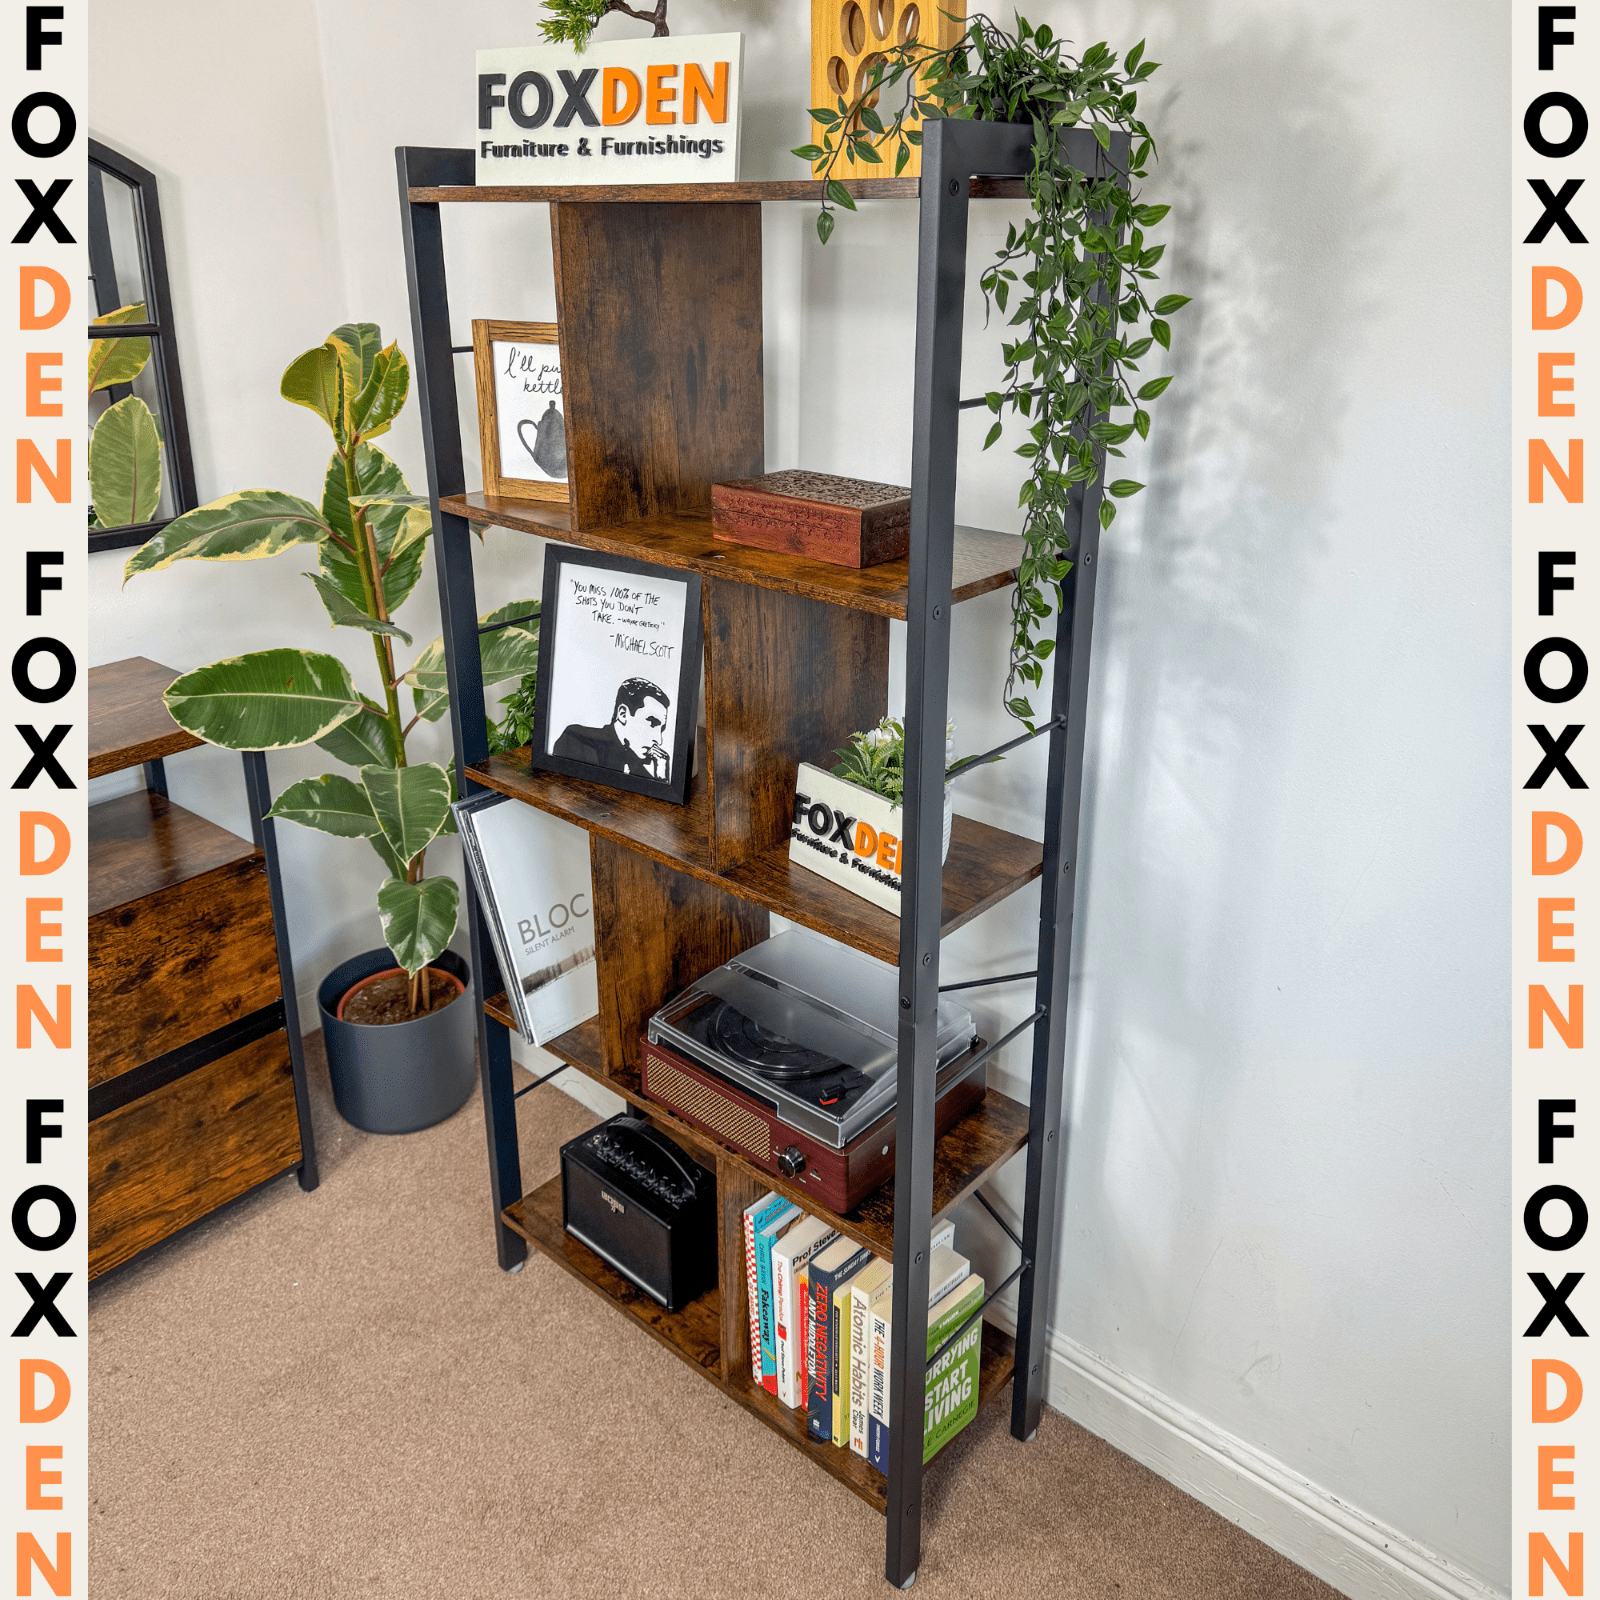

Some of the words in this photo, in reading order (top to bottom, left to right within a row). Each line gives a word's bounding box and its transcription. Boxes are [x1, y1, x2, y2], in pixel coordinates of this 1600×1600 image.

[478, 61, 730, 130] FOXDEN
[480, 139, 570, 159] Furniture
[577, 137, 593, 157] &
[600, 134, 725, 160] Furnishings
[537, 364, 561, 382] pu
[575, 595, 598, 606] SHOTS
[600, 598, 615, 612] YOU
[617, 601, 644, 615] DON'T
[610, 587, 630, 599] 100%
[631, 592, 643, 601] OF
[644, 592, 661, 606] THE
[592, 610, 615, 625] TAKE.
[648, 641, 675, 659] SCOTT
[790, 828, 838, 858] Furniture
[839, 852, 849, 864] &
[517, 893, 590, 945] BLOC
[525, 938, 549, 956] SILENT
[551, 926, 575, 943] ALARM
[792, 1247, 812, 1267] Prof
[813, 1230, 837, 1252] Steve
[834, 1271, 843, 1281] THE
[842, 1259, 860, 1276] SUNDAY
[761, 1288, 770, 1345] Fakeaway
[808, 1294, 817, 1320] ANT
[815, 1282, 828, 1322] ZERO
[853, 1296, 867, 1356] Atomic
[874, 1318, 885, 1338] THE
[808, 1319, 817, 1379] MIDDLETON
[815, 1322, 828, 1402] NEGATIVITY
[873, 1335, 885, 1370] 4-HOUR
[926, 1327, 978, 1386] ORRYING
[852, 1356, 867, 1407] Habits
[873, 1367, 884, 1393] WORK
[925, 1359, 969, 1412] START
[873, 1392, 884, 1420] WEEK
[924, 1376, 972, 1435] IVING
[935, 1399, 975, 1439] CARNEGIE
